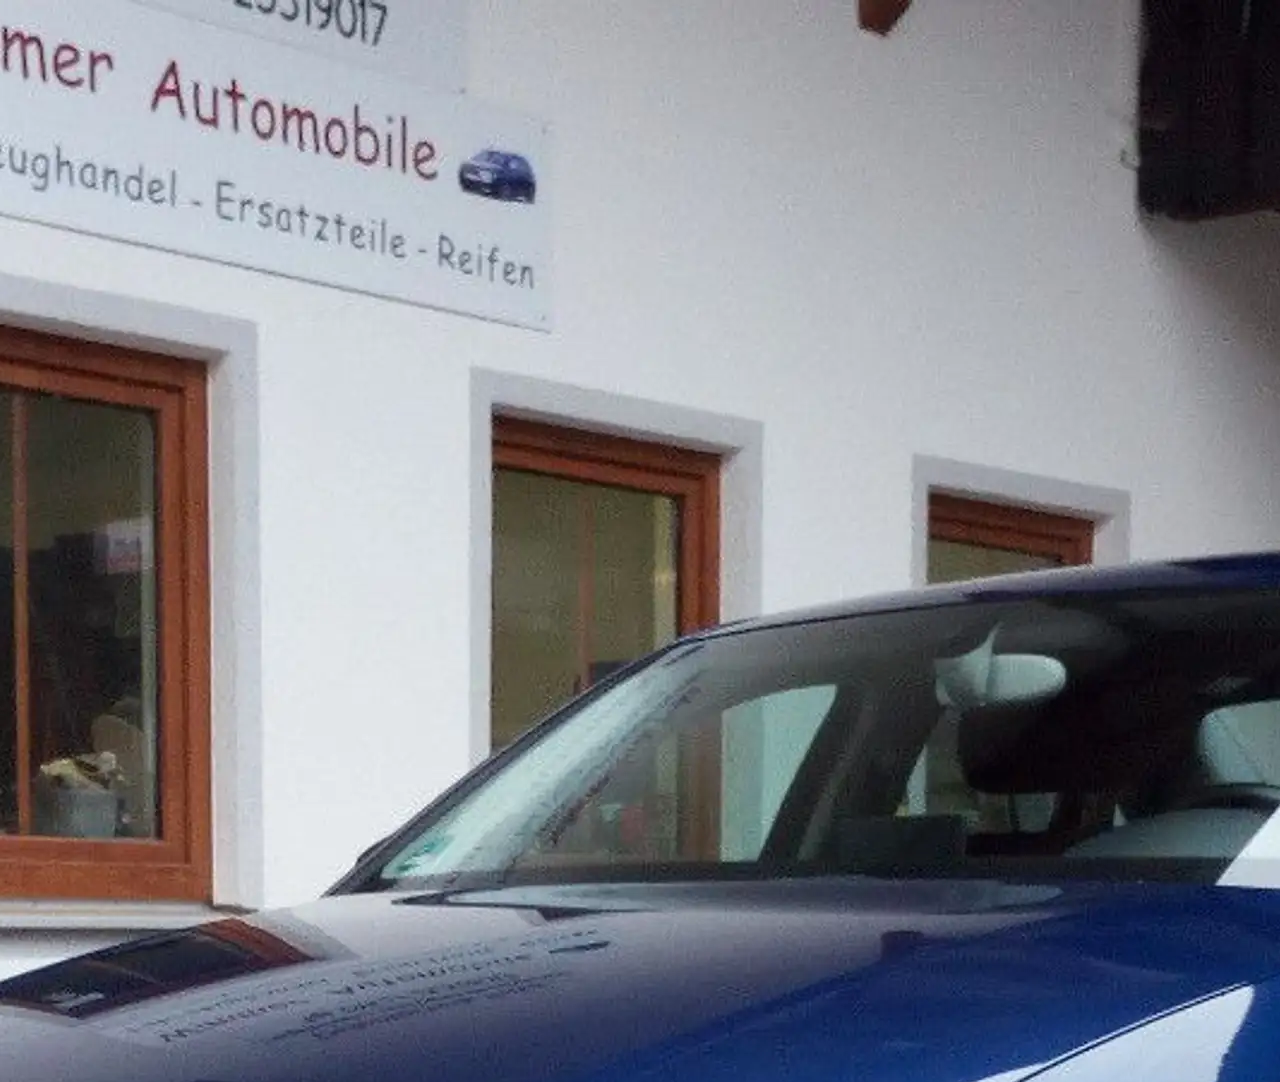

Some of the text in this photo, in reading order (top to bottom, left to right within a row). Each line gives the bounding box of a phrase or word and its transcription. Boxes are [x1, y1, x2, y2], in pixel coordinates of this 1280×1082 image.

[151, 60, 438, 181] Automobile
[214, 179, 408, 259] Ersatzteile
[437, 230, 535, 290] Reifen
